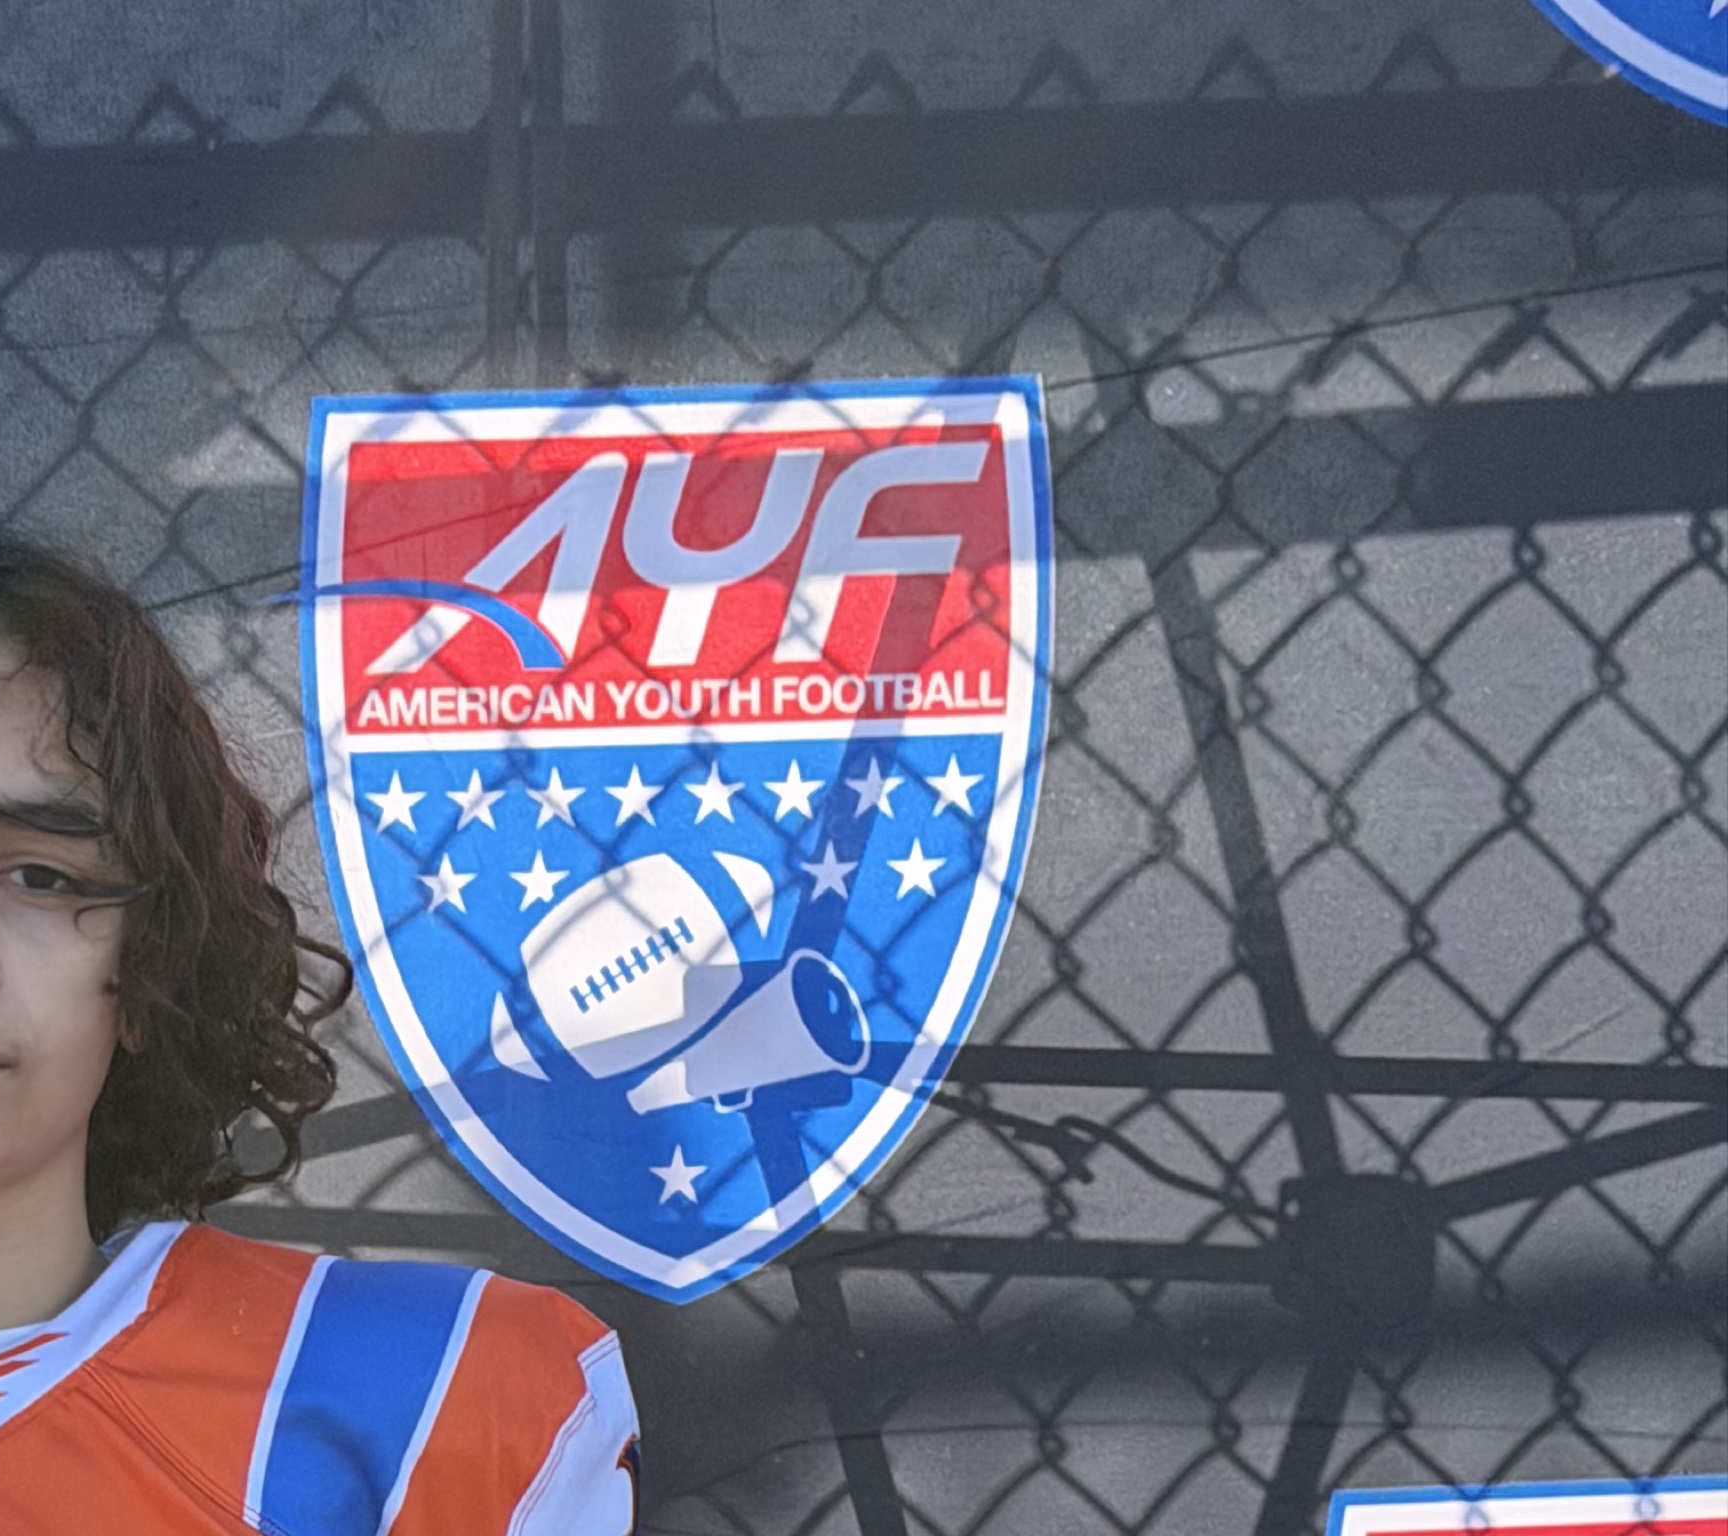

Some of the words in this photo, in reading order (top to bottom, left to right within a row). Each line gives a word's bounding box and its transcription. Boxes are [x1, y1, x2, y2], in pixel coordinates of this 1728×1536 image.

[364, 440, 991, 676] AYF
[357, 683, 595, 728] AMERICAN
[604, 677, 762, 722] YOUTH
[773, 669, 1005, 716] FOOTBALL
